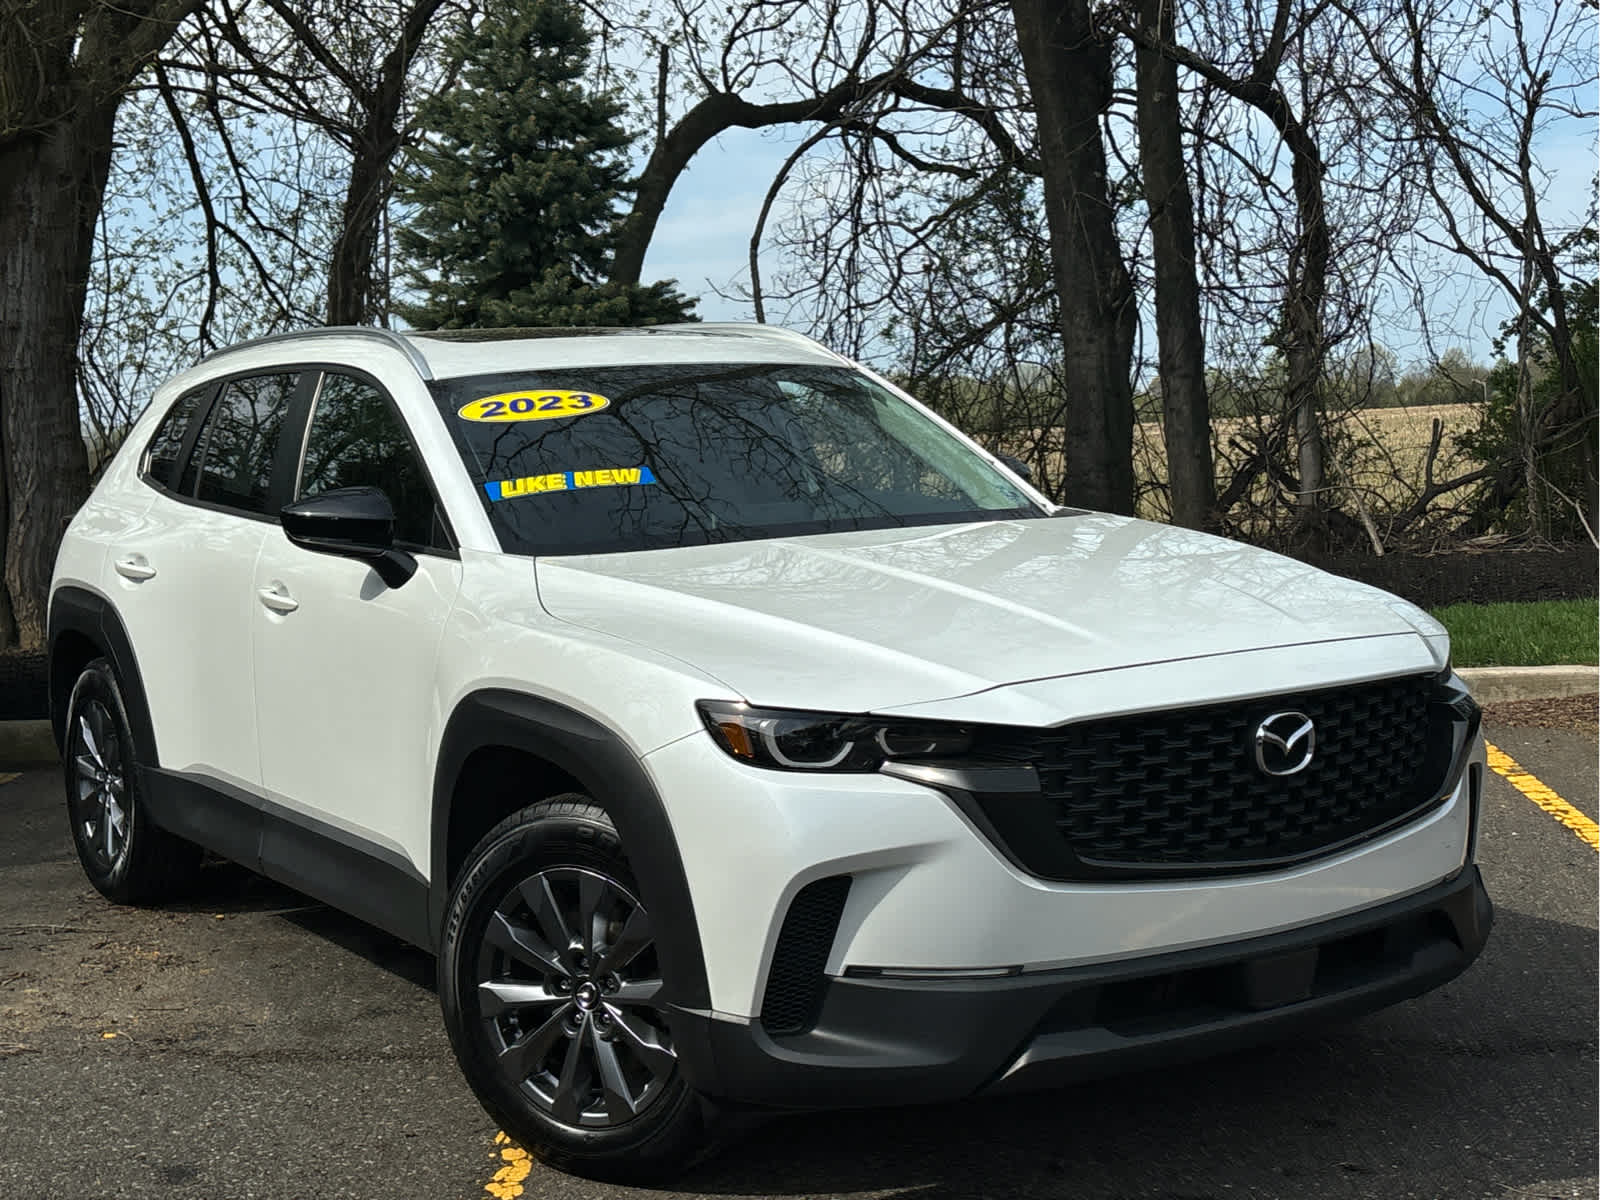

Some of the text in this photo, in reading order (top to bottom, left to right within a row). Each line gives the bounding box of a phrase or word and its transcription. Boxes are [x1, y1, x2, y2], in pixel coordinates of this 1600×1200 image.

[480, 395, 593, 418] 2023
[500, 468, 641, 498] LIKE NEW
